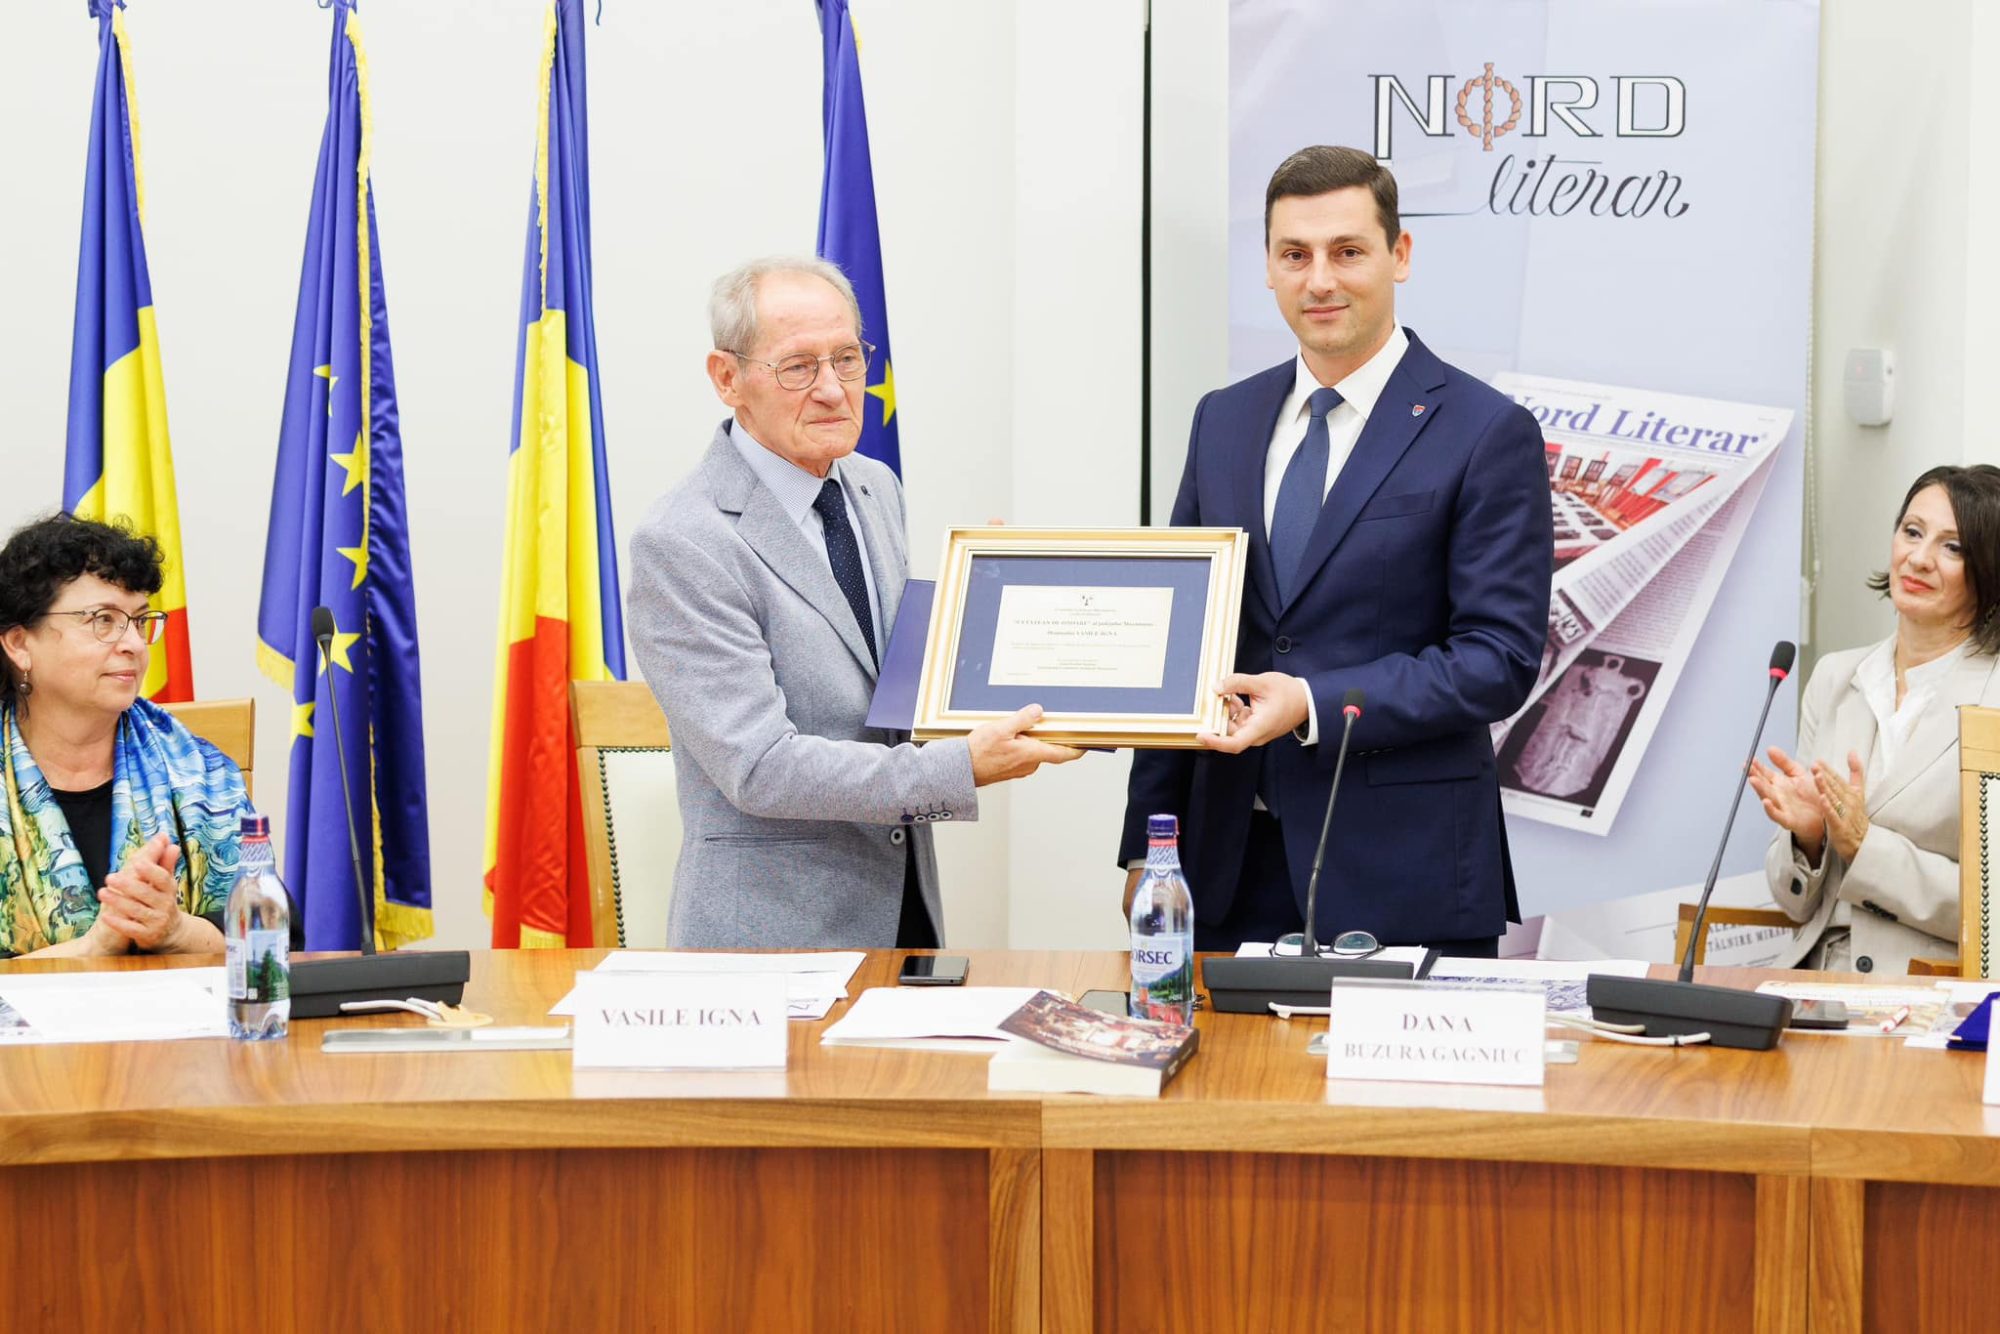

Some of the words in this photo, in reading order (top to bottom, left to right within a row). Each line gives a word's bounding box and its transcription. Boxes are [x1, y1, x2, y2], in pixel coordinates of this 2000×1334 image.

[1368, 62, 1687, 160] NORD
[1488, 154, 1690, 218] literar
[1505, 394, 1602, 431] ord
[1609, 409, 1759, 455] Literar
[1131, 949, 1173, 965] ORSEC
[601, 1008, 689, 1026] VASILE
[699, 1008, 761, 1026] IGNA
[1402, 1013, 1473, 1033] DANA
[1344, 1042, 1427, 1061] BUZURA
[1432, 1046, 1529, 1064] GAGNIUC
